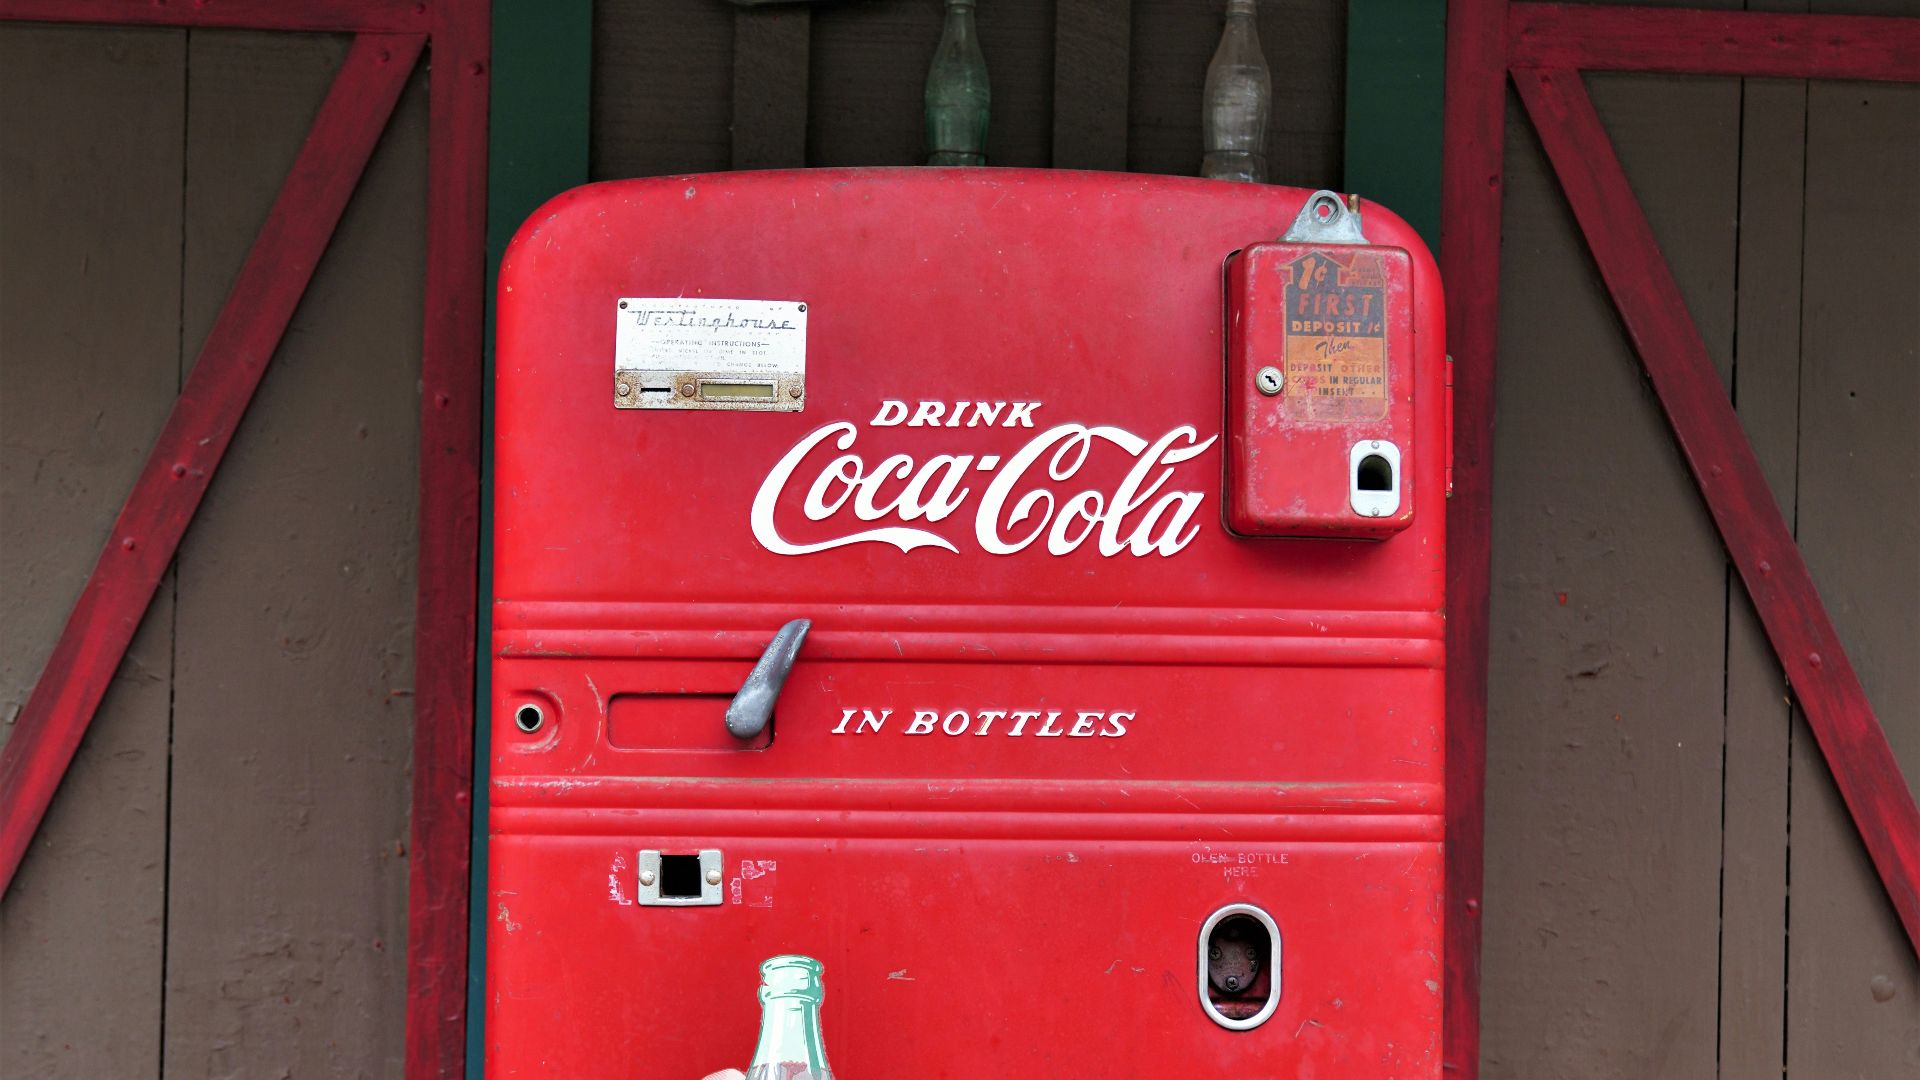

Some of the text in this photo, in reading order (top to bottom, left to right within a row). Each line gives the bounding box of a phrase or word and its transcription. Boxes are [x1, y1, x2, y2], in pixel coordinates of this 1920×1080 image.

[1298, 293, 1374, 317] FIRST
[627, 309, 797, 333] Westinghouse
[1291, 320, 1361, 333] DEPOSIT
[1290, 363, 1381, 374] DEPOSIT OTHER
[1329, 376, 1339, 385] IN
[1343, 376, 1382, 385] REGULAR
[870, 400, 1042, 428] DRINK
[750, 421, 1218, 557] Coca-Cola
[831, 709, 1136, 738] IN BOTTLES
[1238, 852, 1289, 864] BOTTLE
[1223, 866, 1259, 877] HERE
